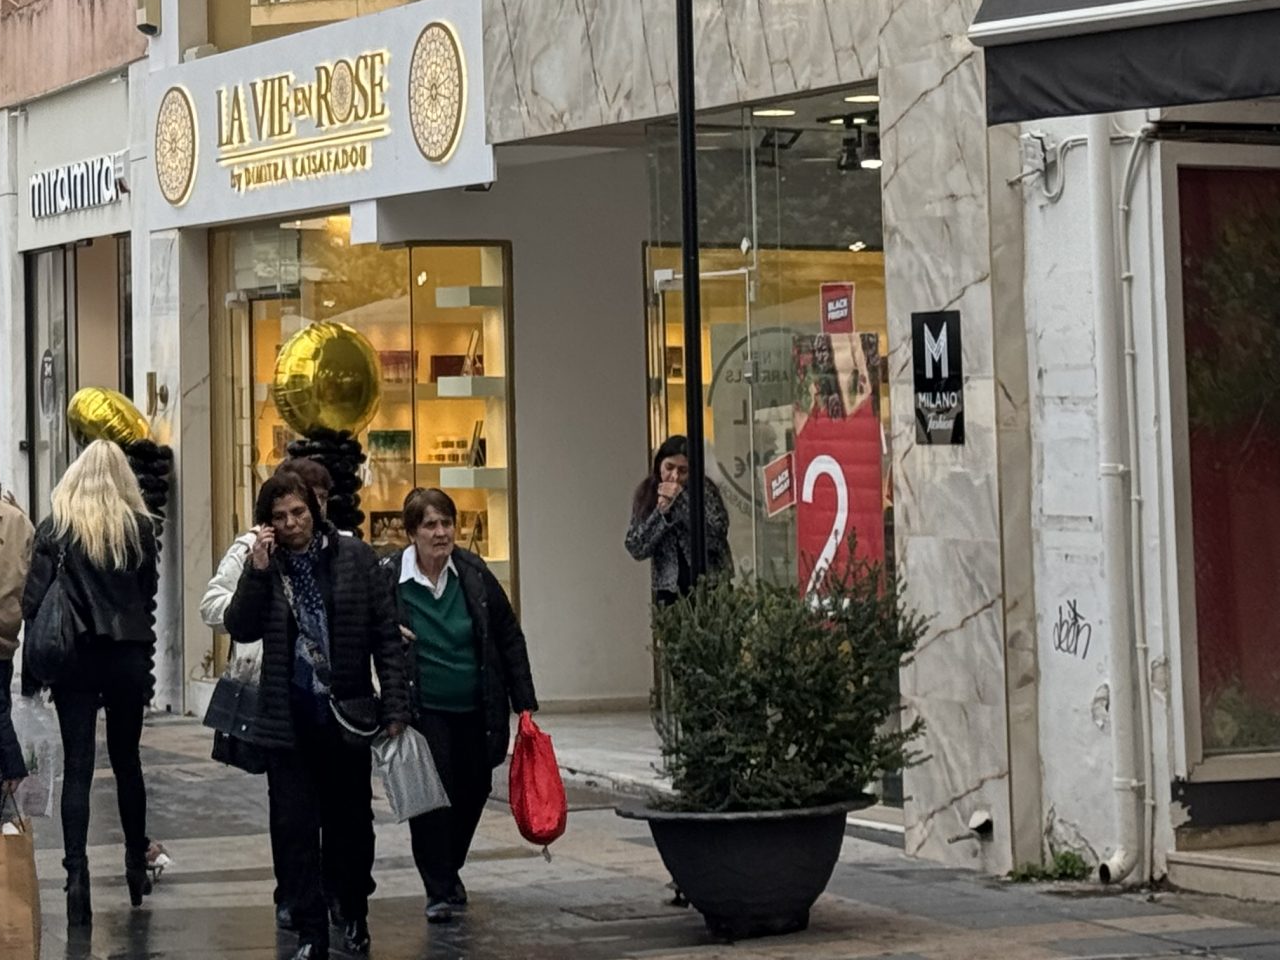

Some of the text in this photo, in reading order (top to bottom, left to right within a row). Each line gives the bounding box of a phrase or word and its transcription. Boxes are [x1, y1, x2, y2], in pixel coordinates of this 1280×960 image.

[216, 51, 387, 149] LA VIE EN ROSE
[918, 391, 958, 409] MILANO
